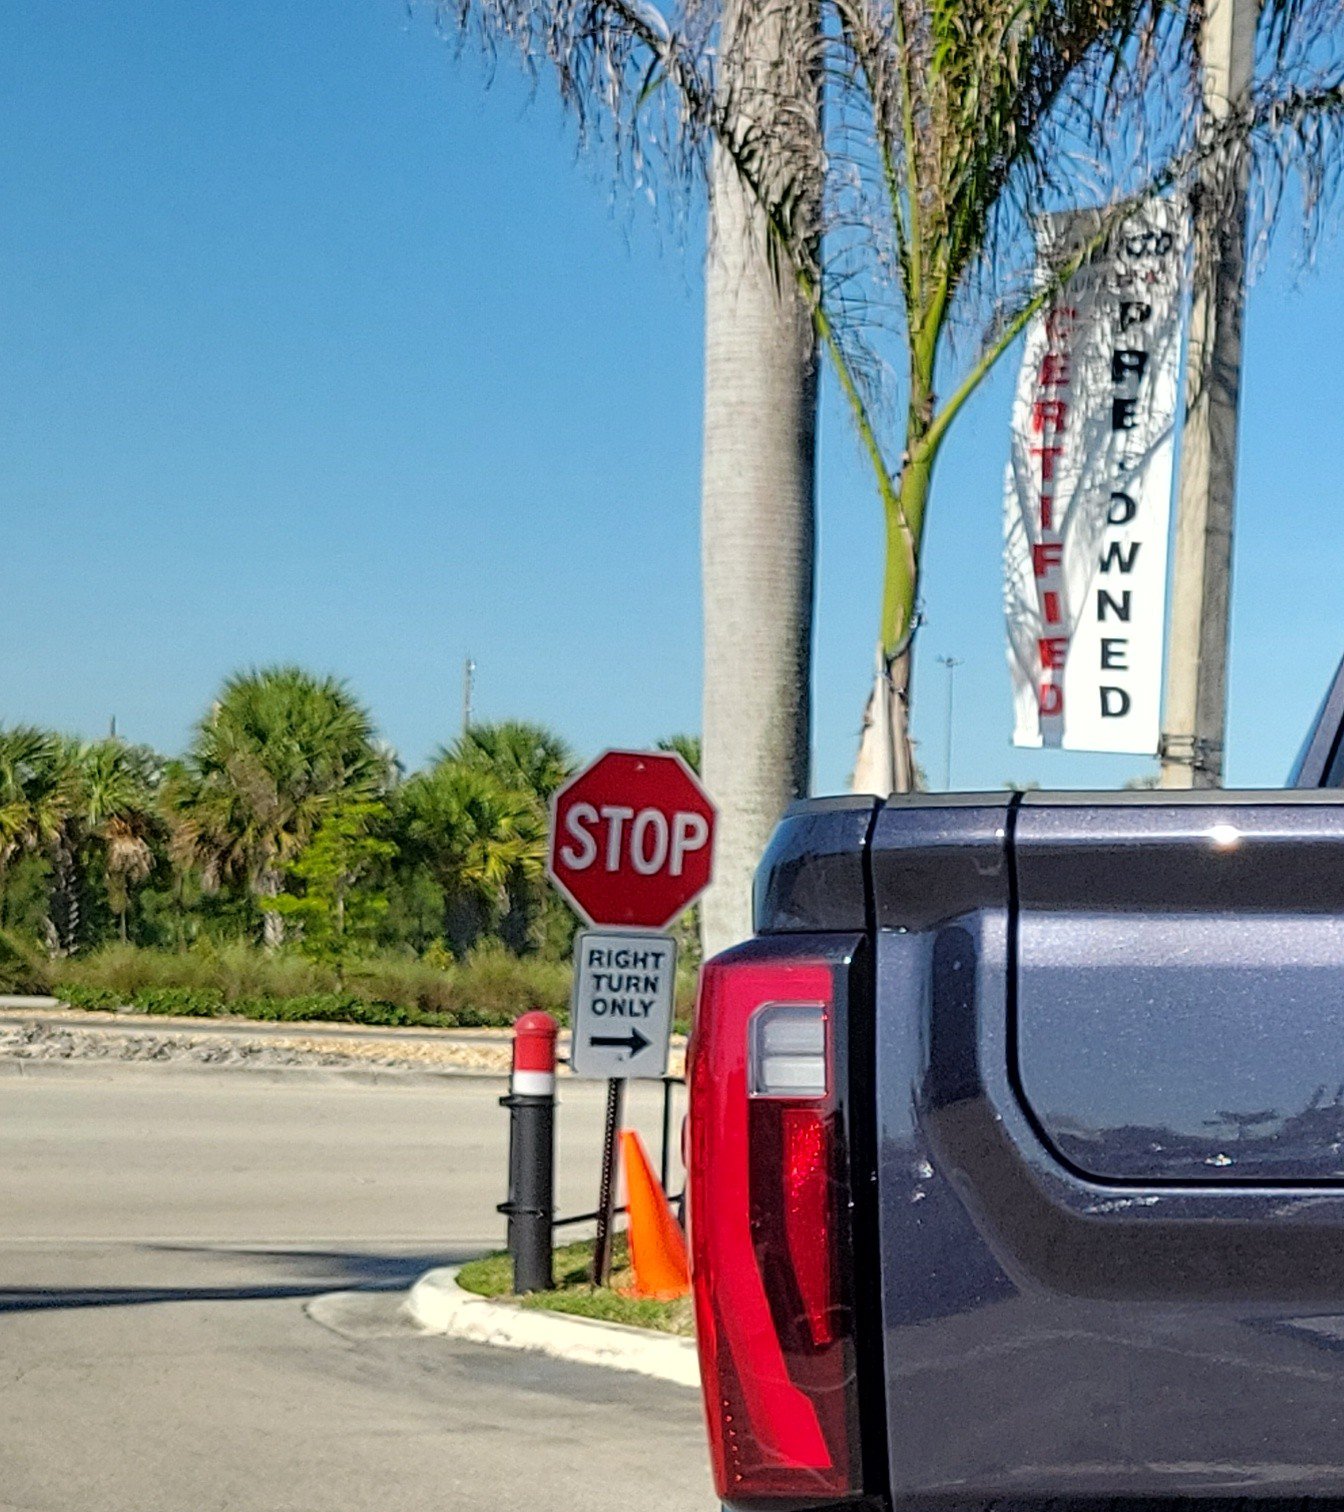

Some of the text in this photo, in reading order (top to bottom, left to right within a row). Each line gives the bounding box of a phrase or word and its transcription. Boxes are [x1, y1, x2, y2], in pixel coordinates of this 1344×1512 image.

[1030, 307, 1076, 717] CERTIFIED
[559, 802, 710, 877] STOP
[588, 949, 666, 971] RIGHT
[590, 973, 661, 995] TURN
[591, 997, 656, 1019] ONLY
